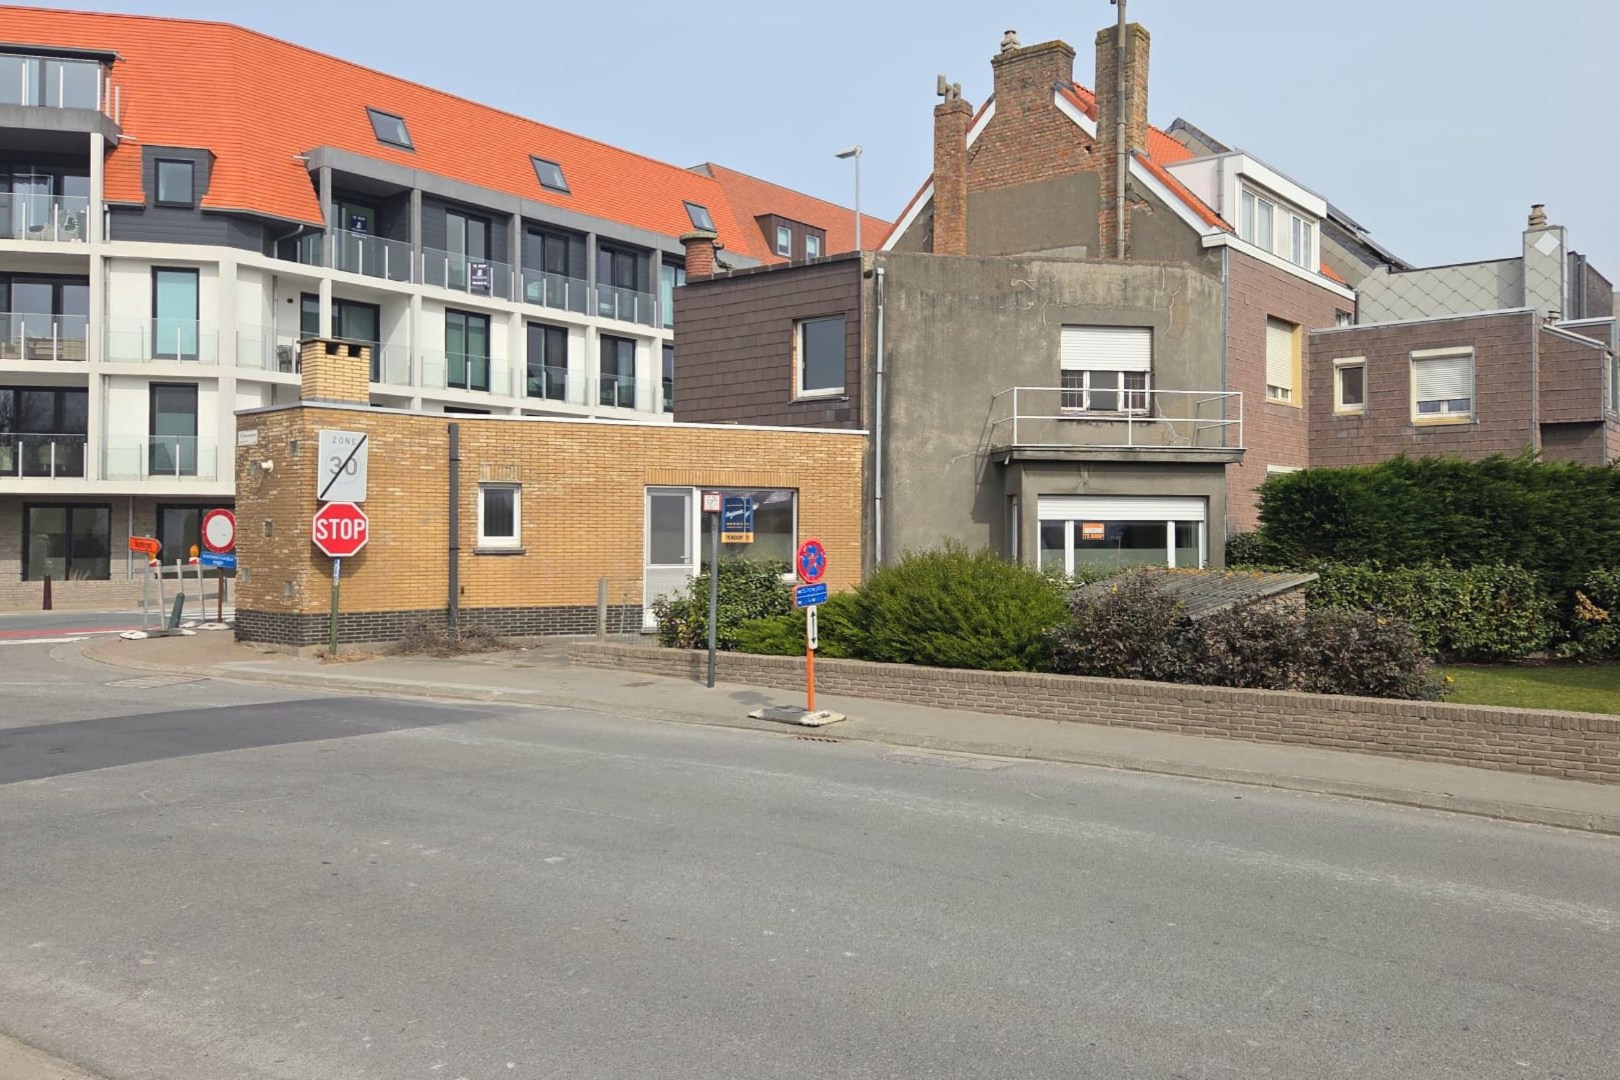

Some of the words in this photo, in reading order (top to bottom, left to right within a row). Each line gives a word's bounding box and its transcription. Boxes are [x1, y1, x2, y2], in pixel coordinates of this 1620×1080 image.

[332, 436, 357, 446] ZONE
[329, 456, 358, 476] 30
[316, 518, 366, 540] STOP
